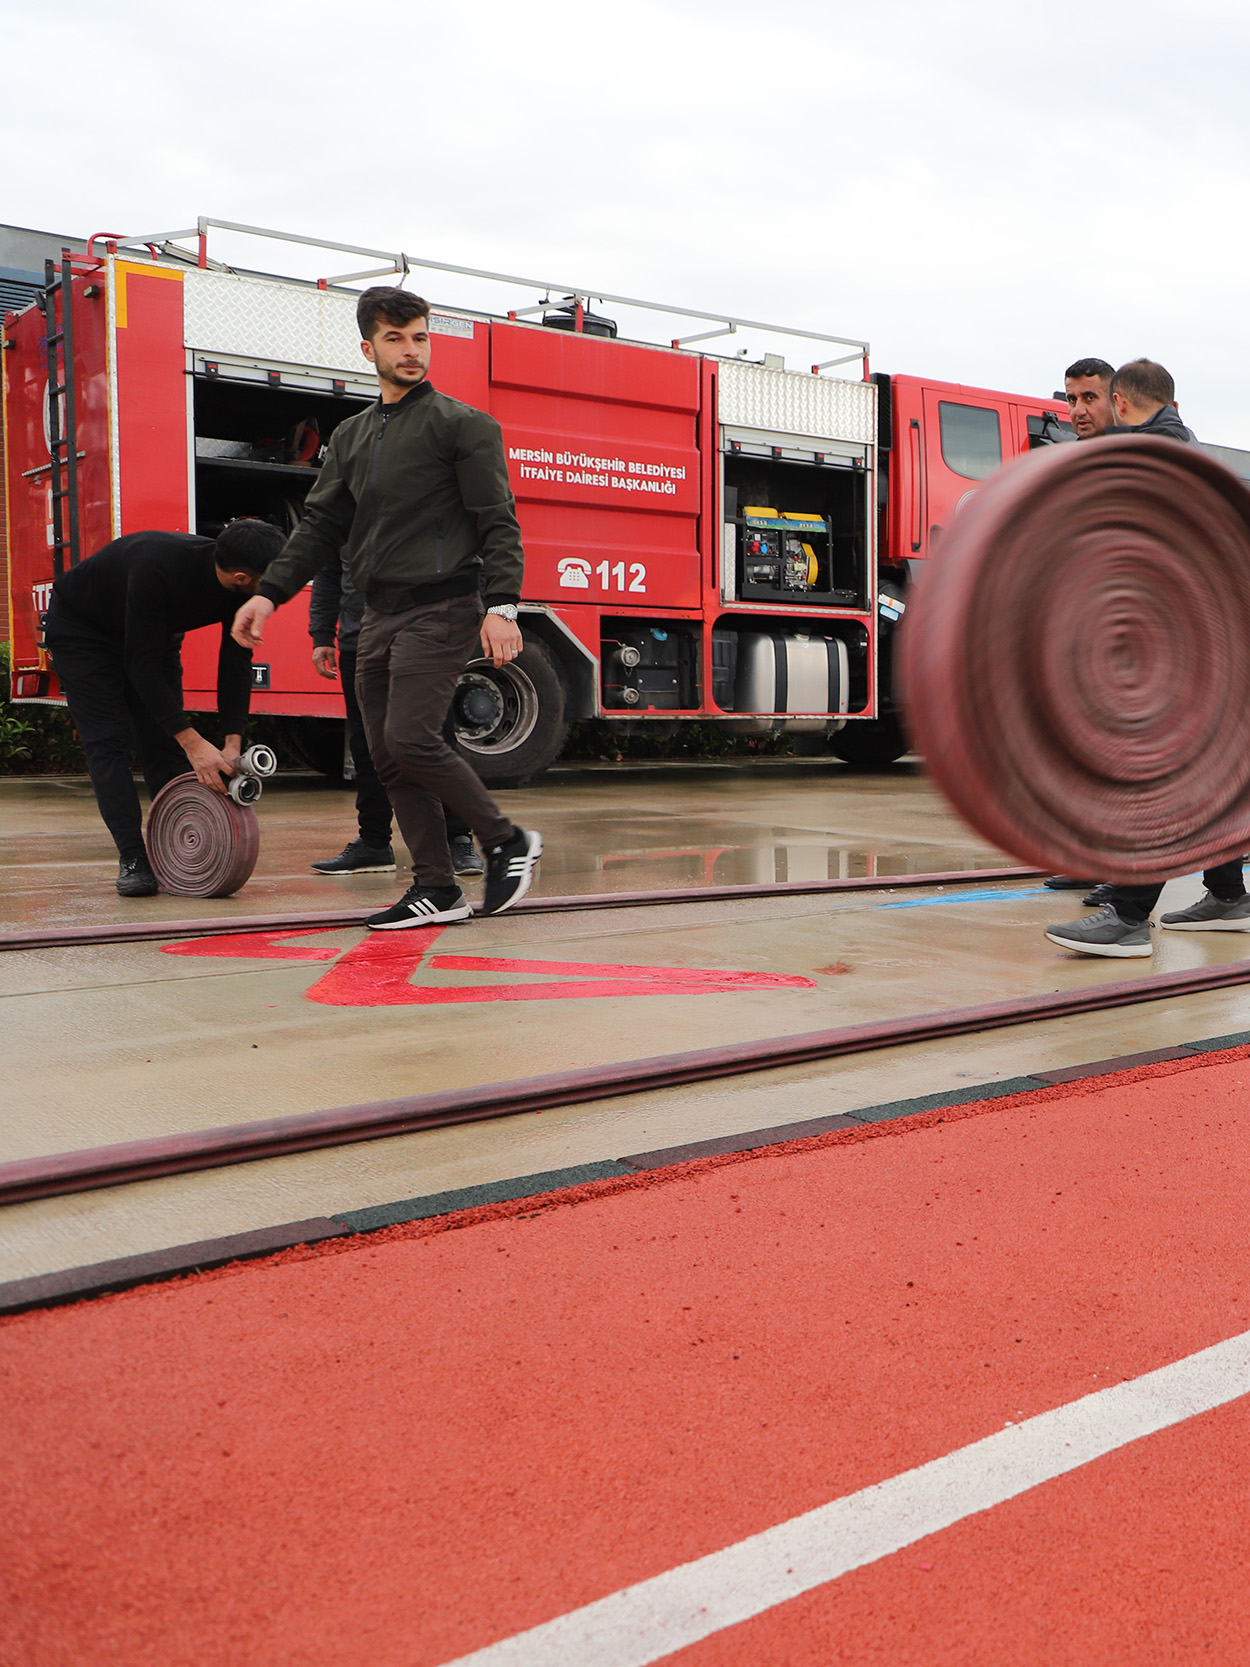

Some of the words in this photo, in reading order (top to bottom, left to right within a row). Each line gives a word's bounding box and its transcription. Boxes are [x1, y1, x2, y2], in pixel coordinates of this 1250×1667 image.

[509, 448, 553, 464] MERSİN
[556, 451, 626, 472] BÜYÜKŞEHİR
[628, 462, 686, 480] BELEDİYESİ
[520, 464, 564, 482] İTFAİYE
[566, 470, 609, 487] DAİRESİ
[611, 477, 677, 494] BAŞKANLIĞI
[596, 560, 647, 593] 112
